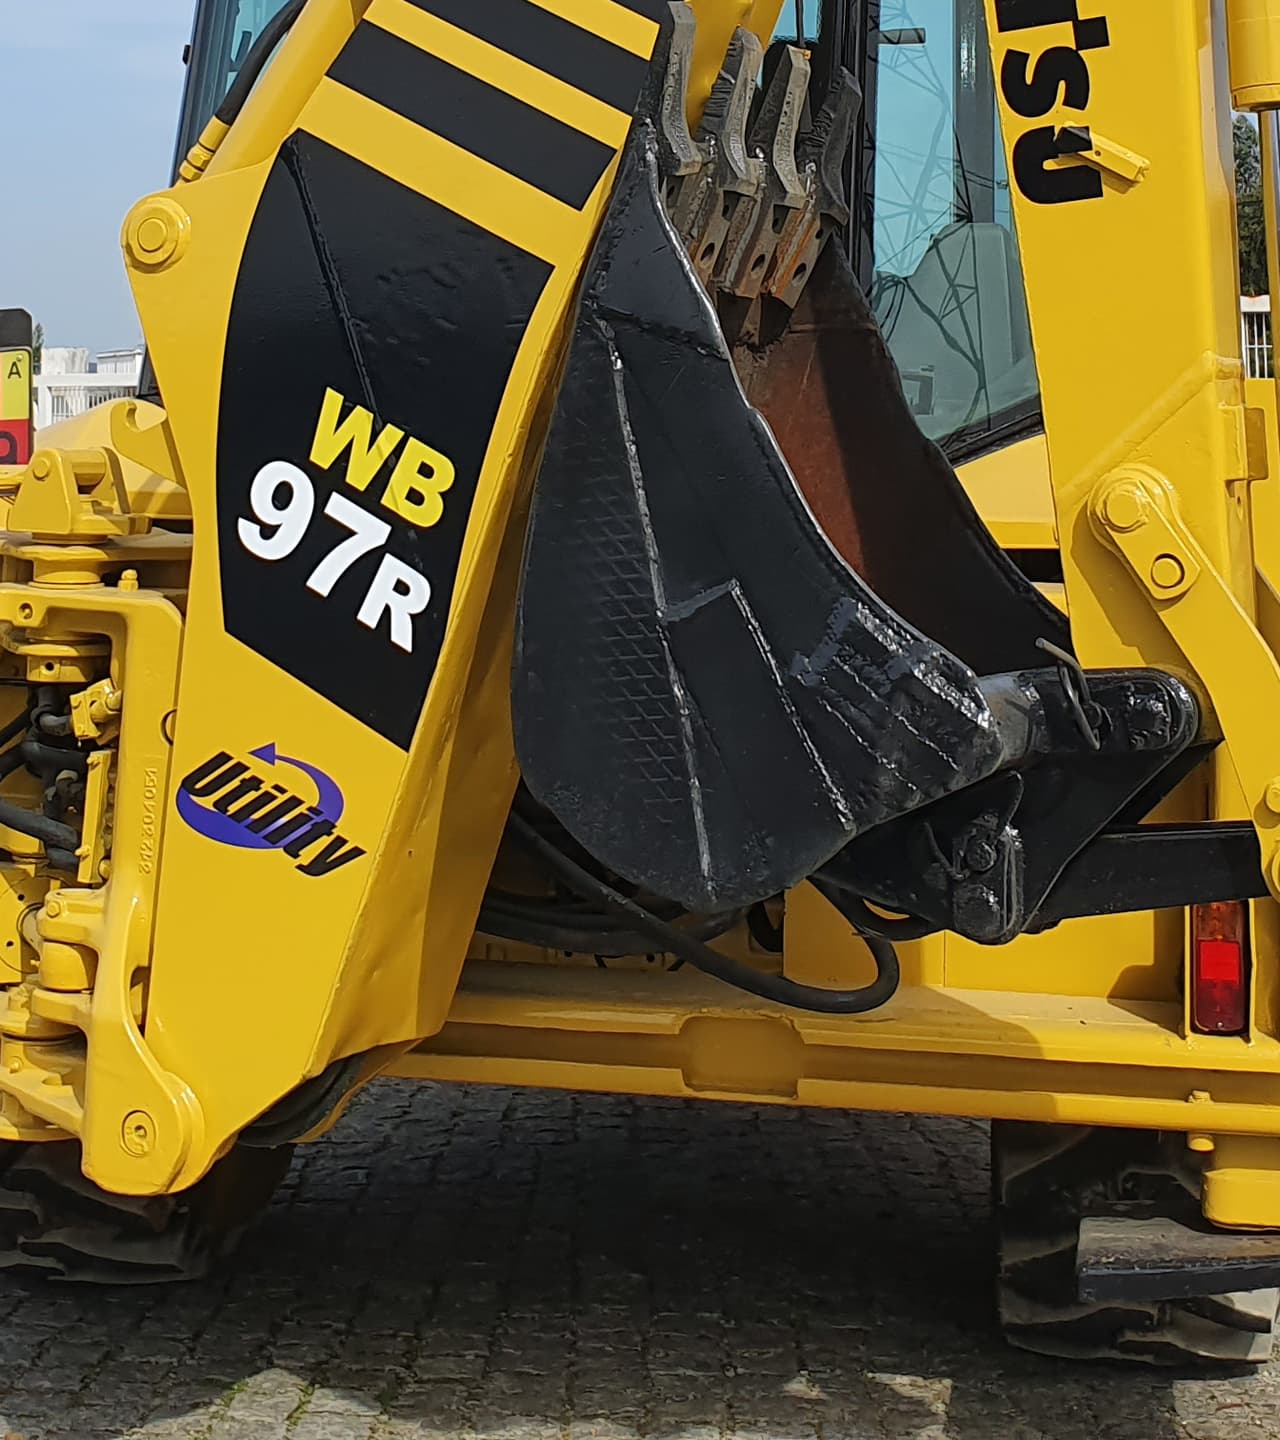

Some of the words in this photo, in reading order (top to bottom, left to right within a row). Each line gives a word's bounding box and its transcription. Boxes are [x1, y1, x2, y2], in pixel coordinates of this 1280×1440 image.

[8, 361, 22, 379] A
[309, 387, 456, 527] WB
[236, 460, 431, 653] 97R
[180, 751, 367, 877] Utility
